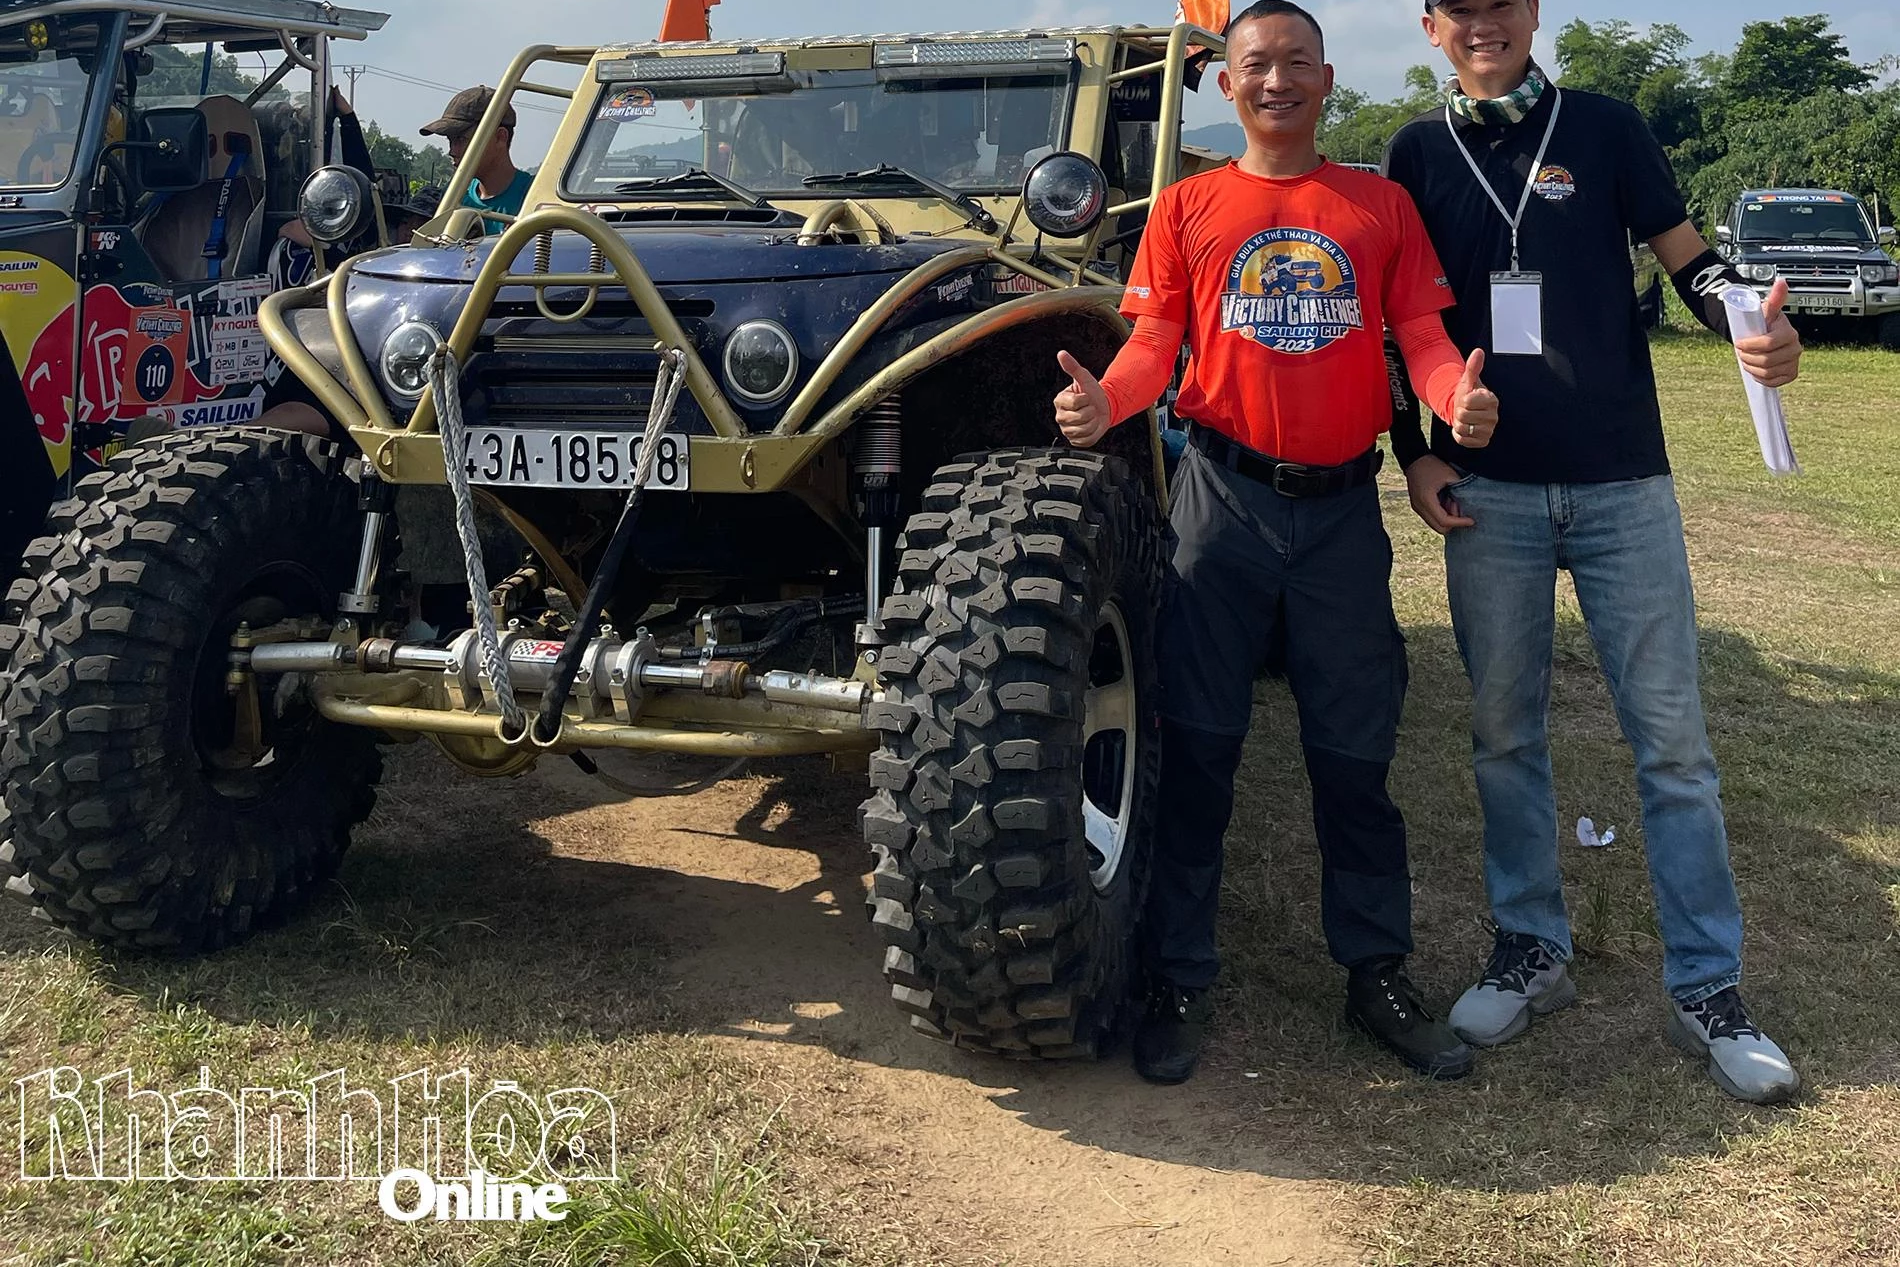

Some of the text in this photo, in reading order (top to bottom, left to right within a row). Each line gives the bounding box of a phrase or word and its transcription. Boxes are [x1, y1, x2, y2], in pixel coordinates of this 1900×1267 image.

[1253, 235, 1265, 247] XE
[1283, 230, 1308, 240] THAO
[1310, 233, 1321, 244] VÀ
[1221, 294, 1363, 329] VICTORY CHALLENGE
[228, 320, 260, 330] NGUYE
[1257, 326, 1348, 339] SAILUN CUP
[1273, 338, 1316, 352] 2025
[243, 355, 261, 367] Ford
[145, 365, 166, 388] 110
[180, 403, 256, 427] SAILUN
